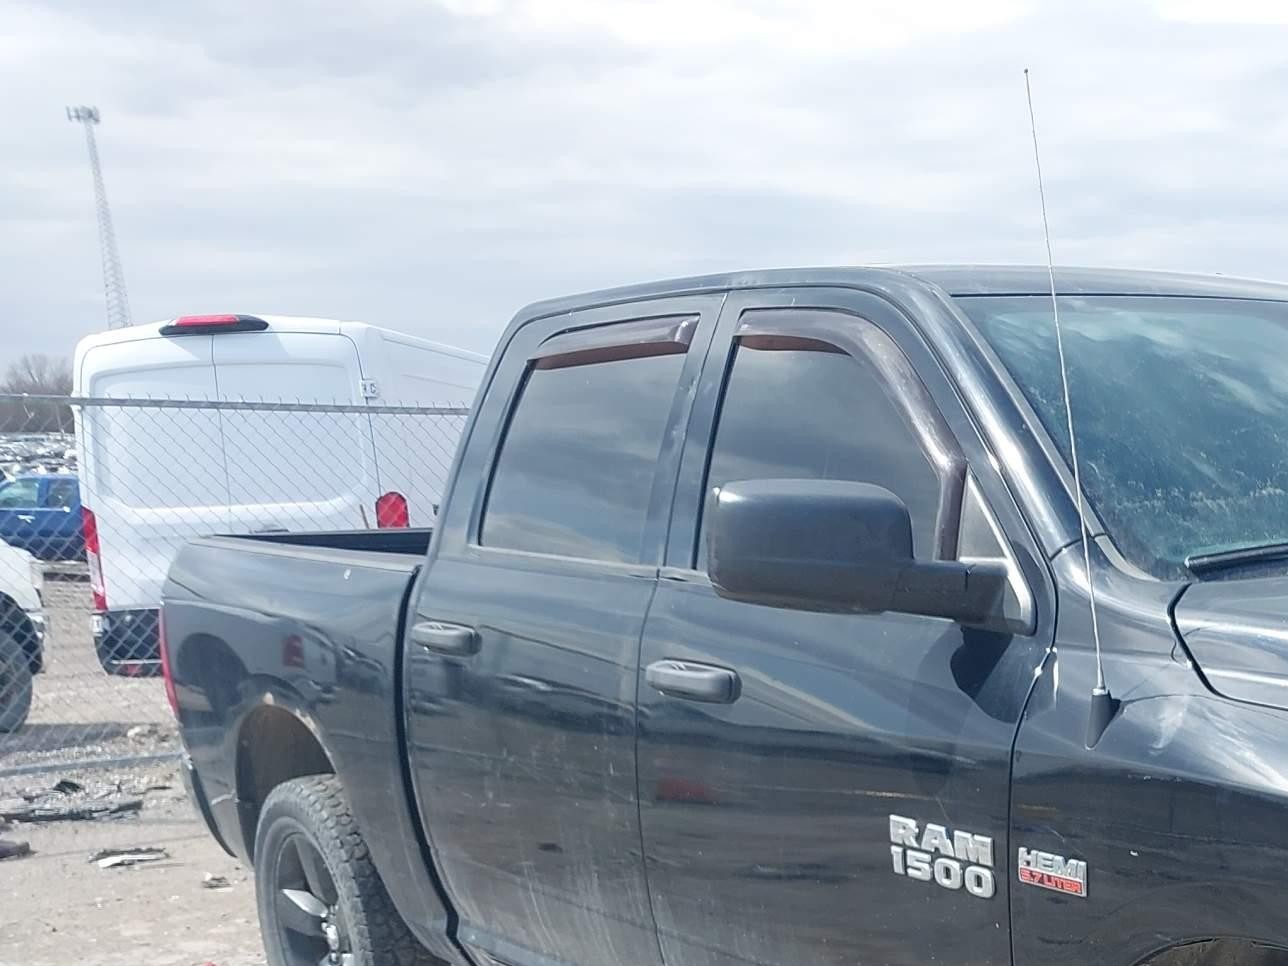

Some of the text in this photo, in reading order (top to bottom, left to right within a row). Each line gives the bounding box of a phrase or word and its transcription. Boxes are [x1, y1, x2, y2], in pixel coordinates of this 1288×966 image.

[889, 814, 994, 867] RAM
[890, 845, 996, 898] 1500
[1018, 847, 1088, 881] HEMI
[1042, 873, 1083, 895] LITER
